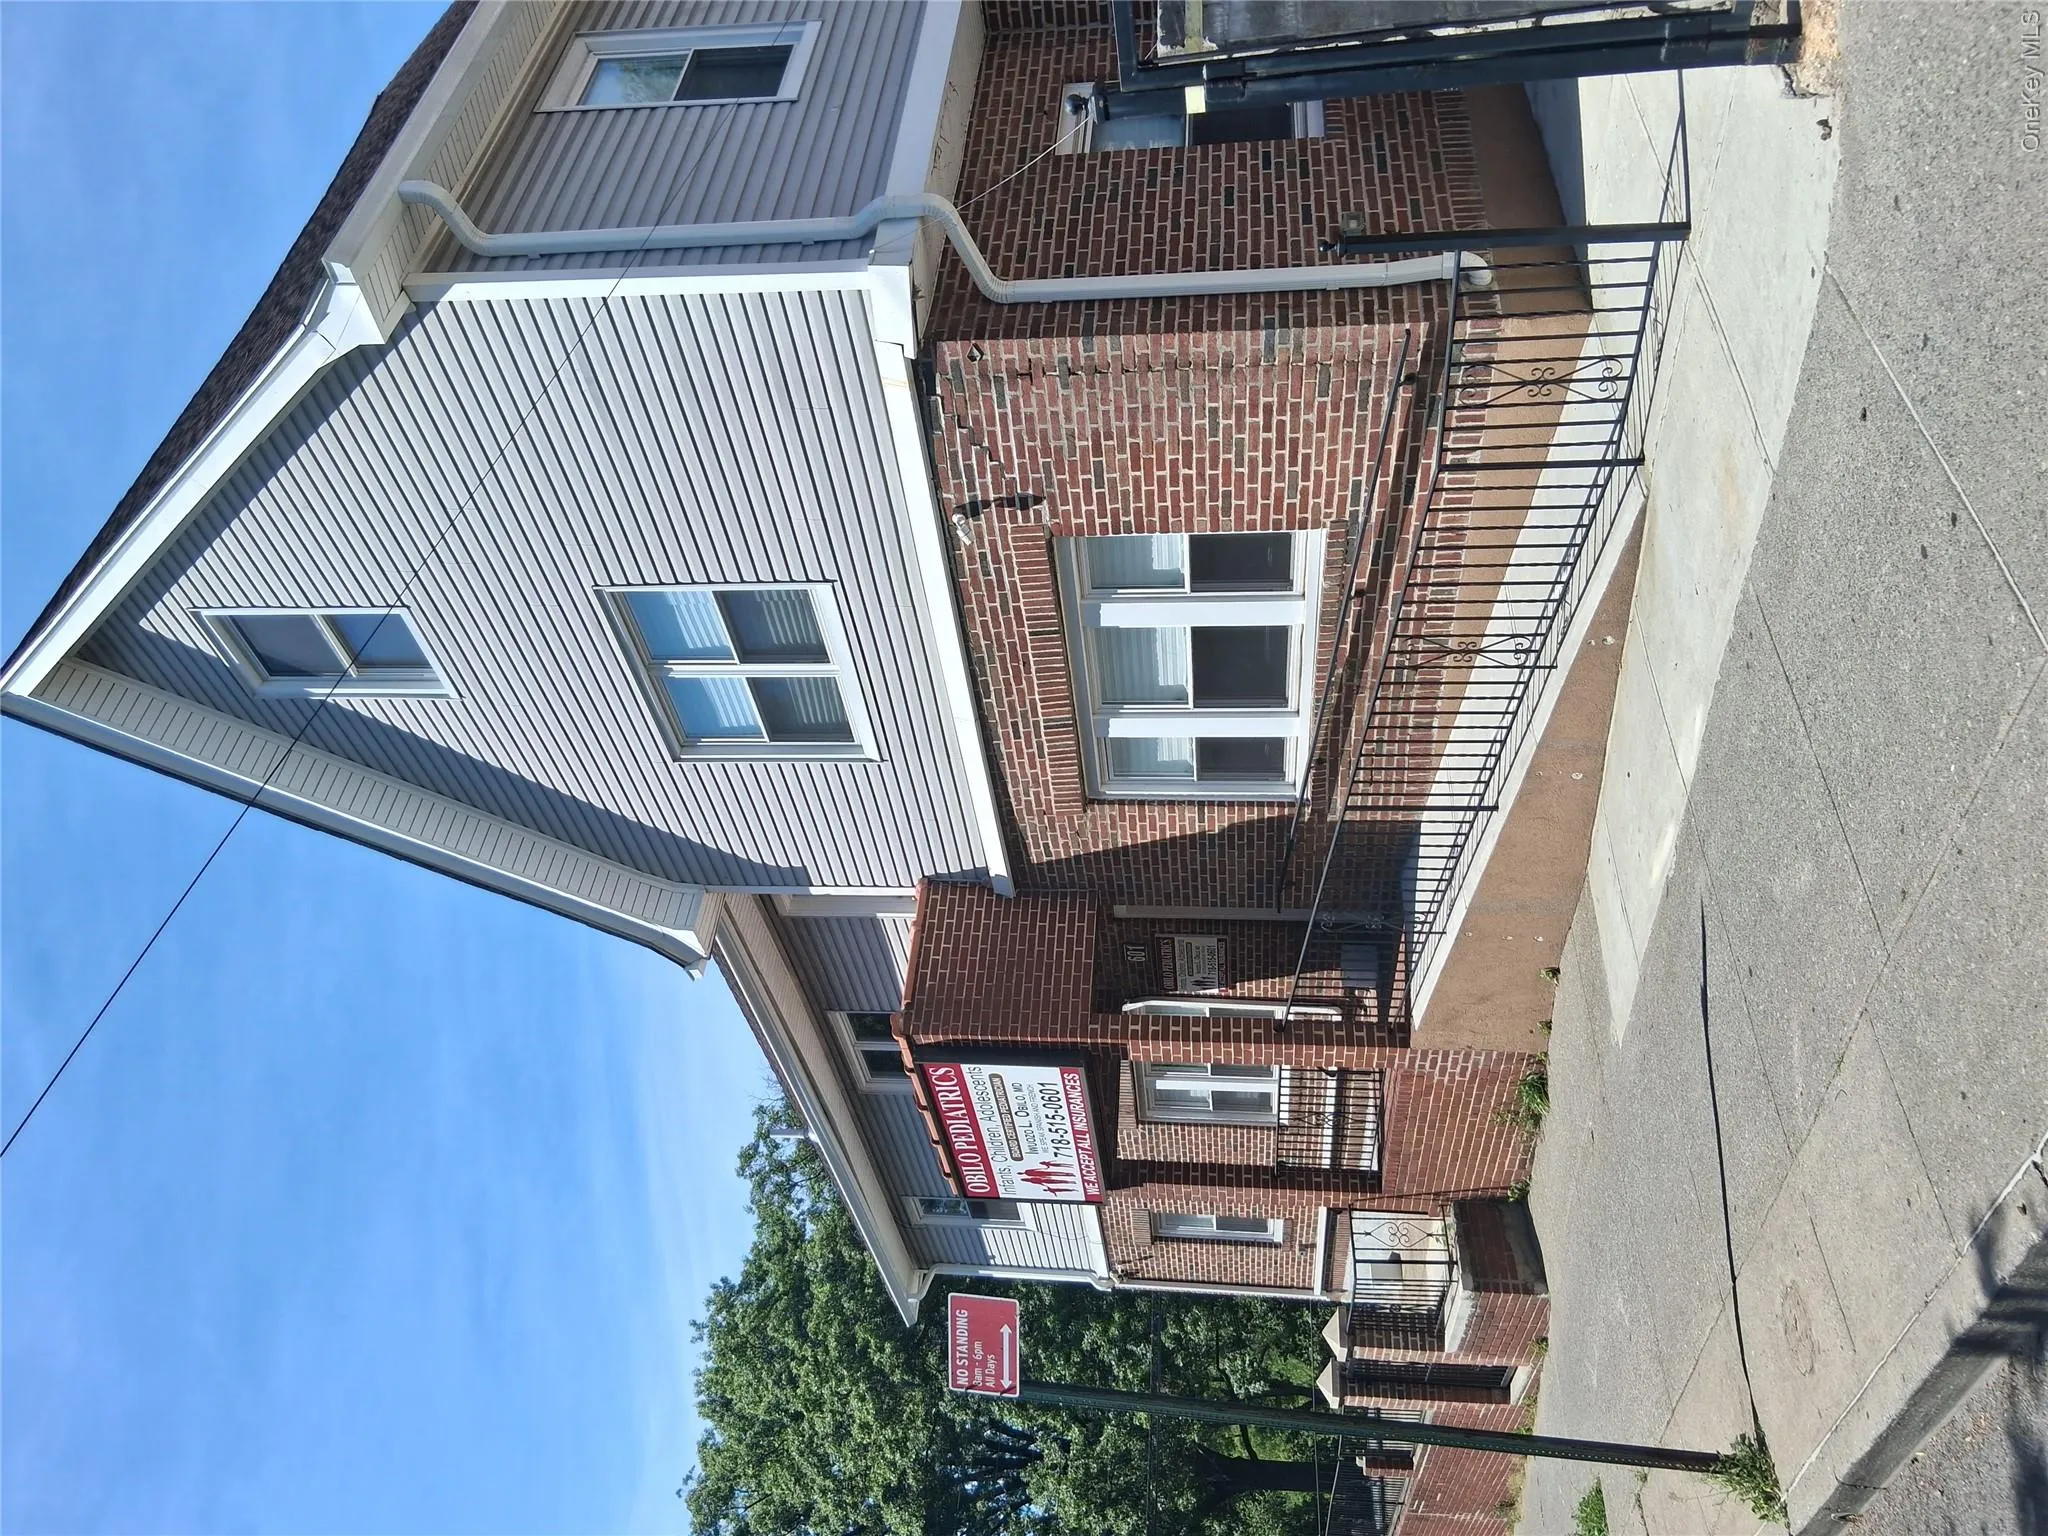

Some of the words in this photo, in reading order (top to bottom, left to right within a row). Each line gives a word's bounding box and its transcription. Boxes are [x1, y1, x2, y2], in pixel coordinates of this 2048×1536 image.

[1126, 945, 1145, 961] 601
[1160, 939, 1173, 971] PEDIATRICS
[1162, 972, 1174, 989] OBILO
[966, 1066, 996, 1122] Adolescents
[992, 1077, 1011, 1114] PEDIATRICIAN
[1012, 1082, 1023, 1092] MD
[1027, 1084, 1037, 1102] FRENCH
[928, 1066, 978, 1150] PEDIATRICS
[1031, 1103, 1039, 1112] AND
[1064, 1073, 1088, 1131] INSURANCES
[1003, 1114, 1018, 1139] CERTIFIED
[1034, 1112, 1045, 1131] SPANISH
[1037, 1082, 1074, 1158] 718-515-0601
[986, 1125, 1008, 1162] Children,
[1039, 1132, 1048, 1146] SPEAK
[1076, 1133, 1092, 1150] ALL
[1010, 1140, 1021, 1158] BOARD
[958, 1153, 990, 1192] OBILO
[1079, 1151, 1096, 1181] ACCEPT
[997, 1165, 1016, 1195] Infants,
[1084, 1181, 1100, 1195] WE
[956, 1309, 968, 1366] STANDING
[972, 1341, 984, 1360] 6pm
[985, 1354, 997, 1374] Days
[957, 1369, 968, 1385] NO
[985, 1377, 995, 1388] All
